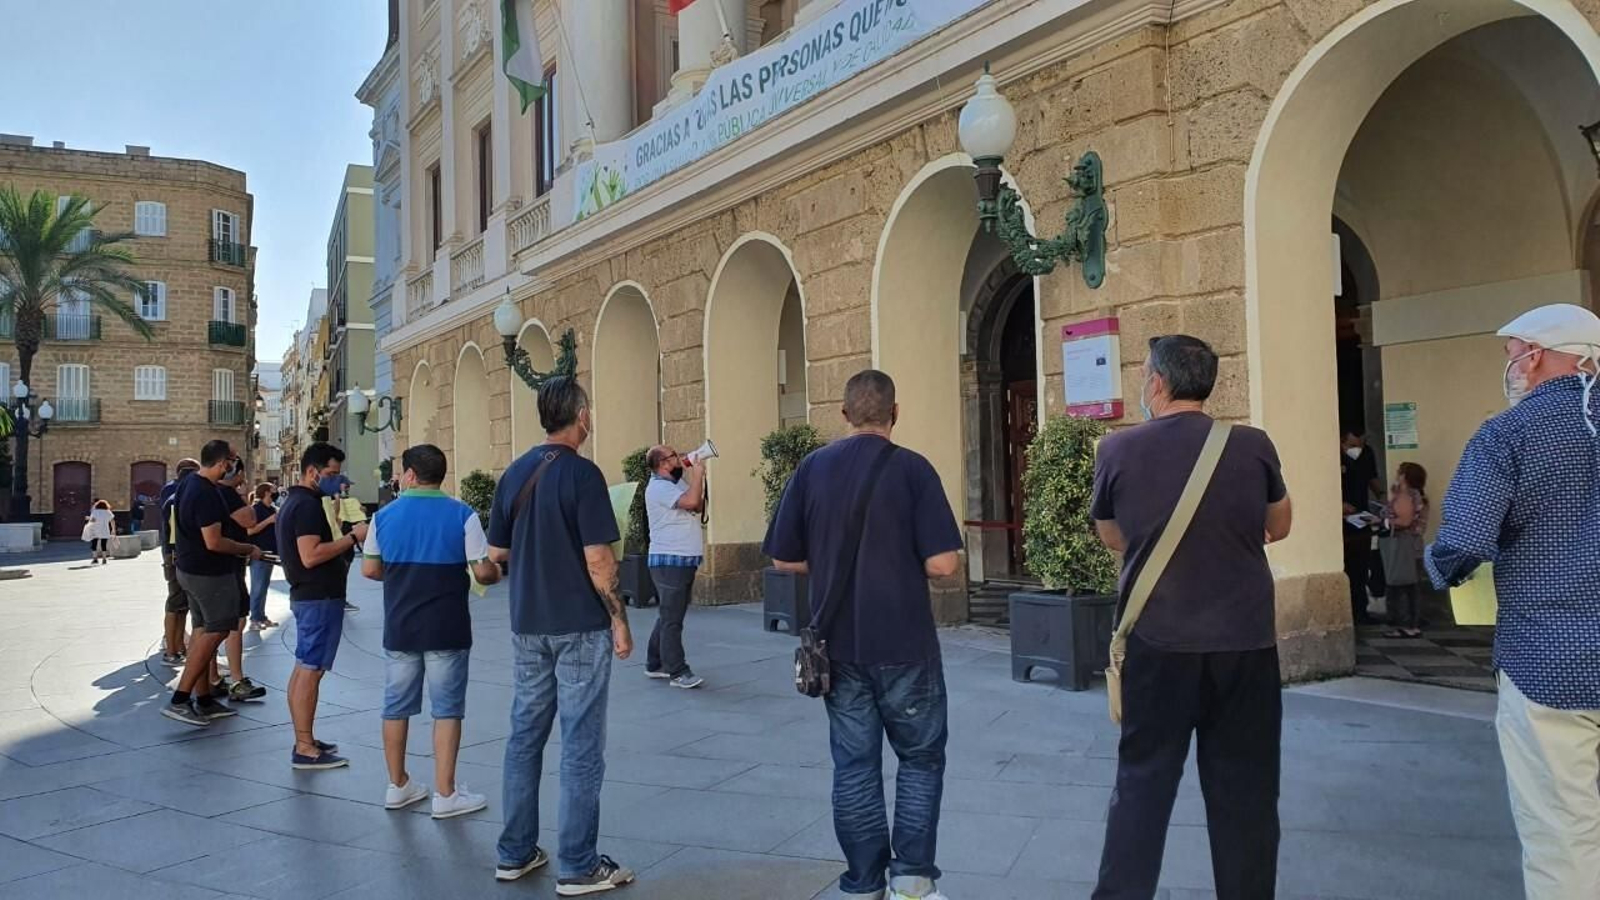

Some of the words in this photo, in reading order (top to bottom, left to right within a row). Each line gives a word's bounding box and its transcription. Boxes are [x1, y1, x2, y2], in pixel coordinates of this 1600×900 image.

[636, 122, 681, 168] GRACIAS
[683, 117, 691, 140] A
[719, 73, 753, 110] LAS
